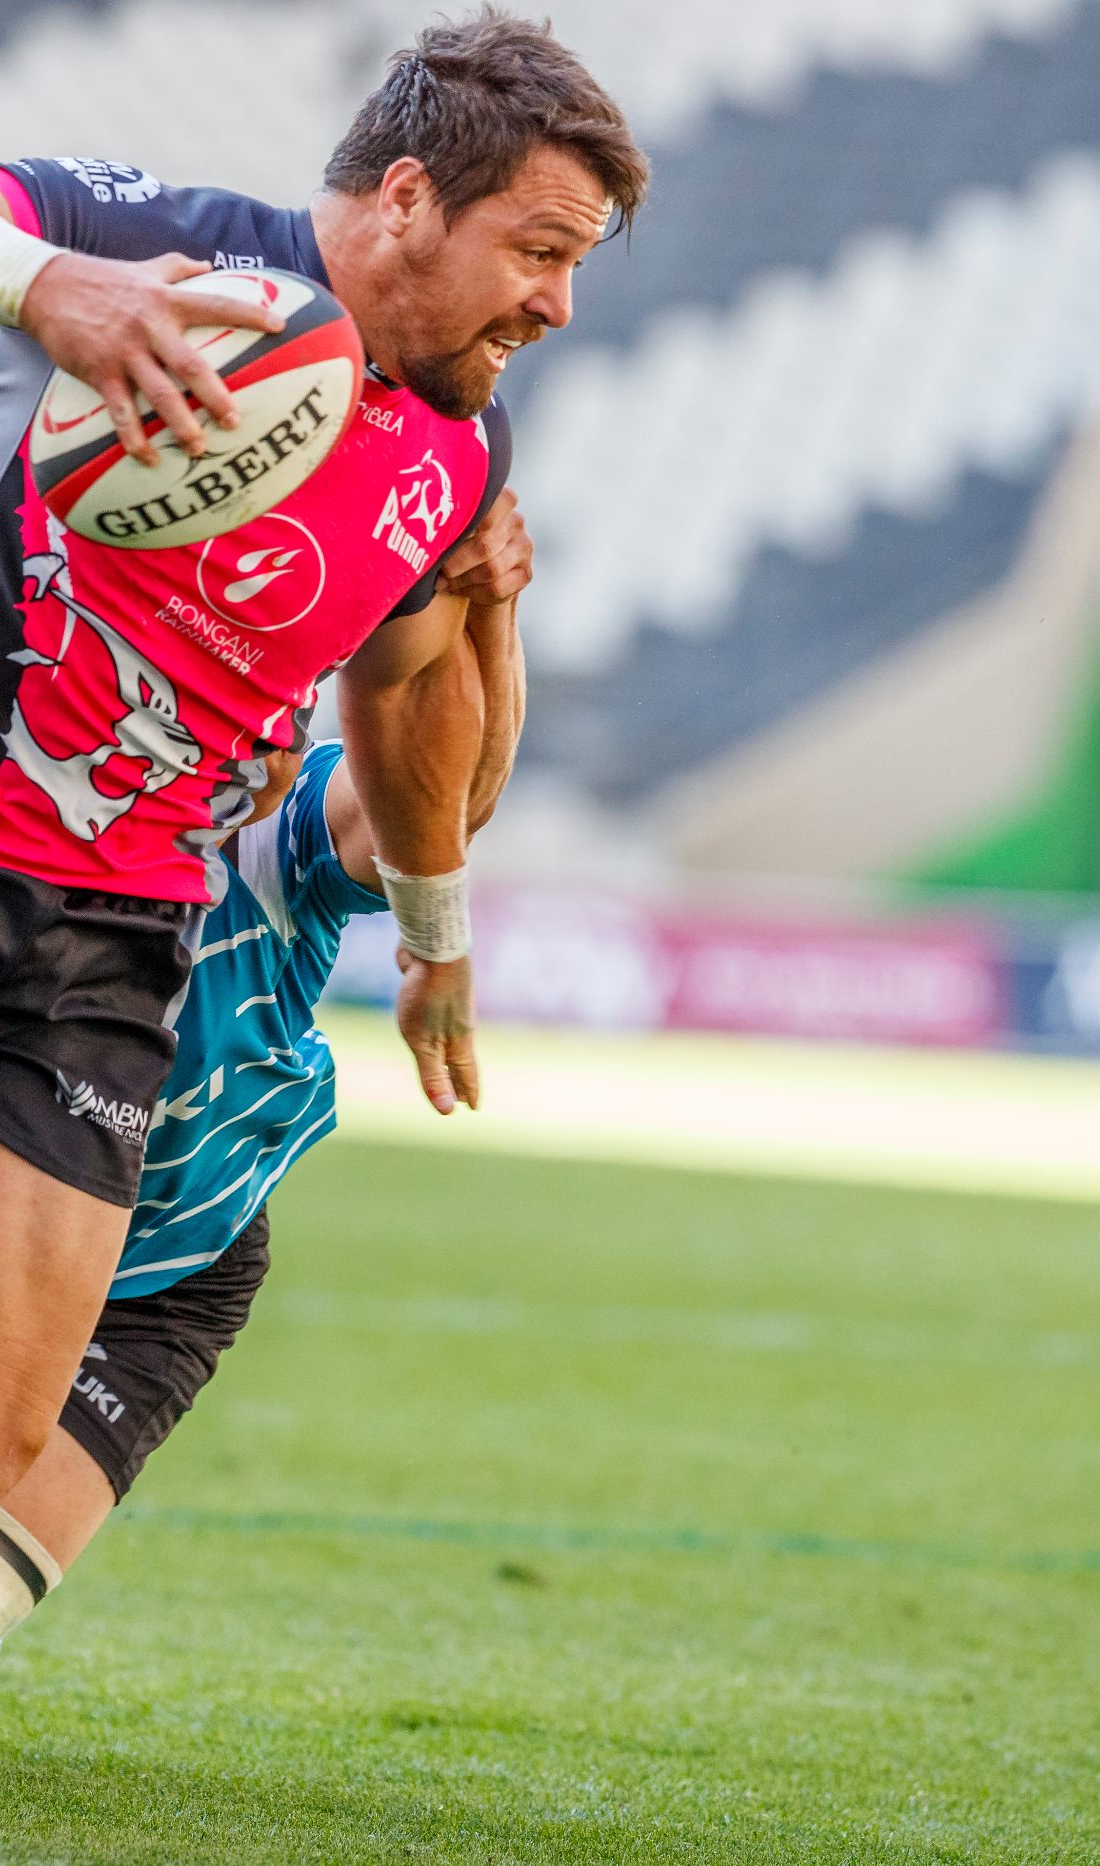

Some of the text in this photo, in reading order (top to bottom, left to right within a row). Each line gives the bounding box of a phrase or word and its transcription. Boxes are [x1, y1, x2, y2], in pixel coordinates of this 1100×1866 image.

[95, 387, 329, 538] GILBERT
[166, 595, 265, 665] BONGANI
[94, 1096, 149, 1132] MBN
